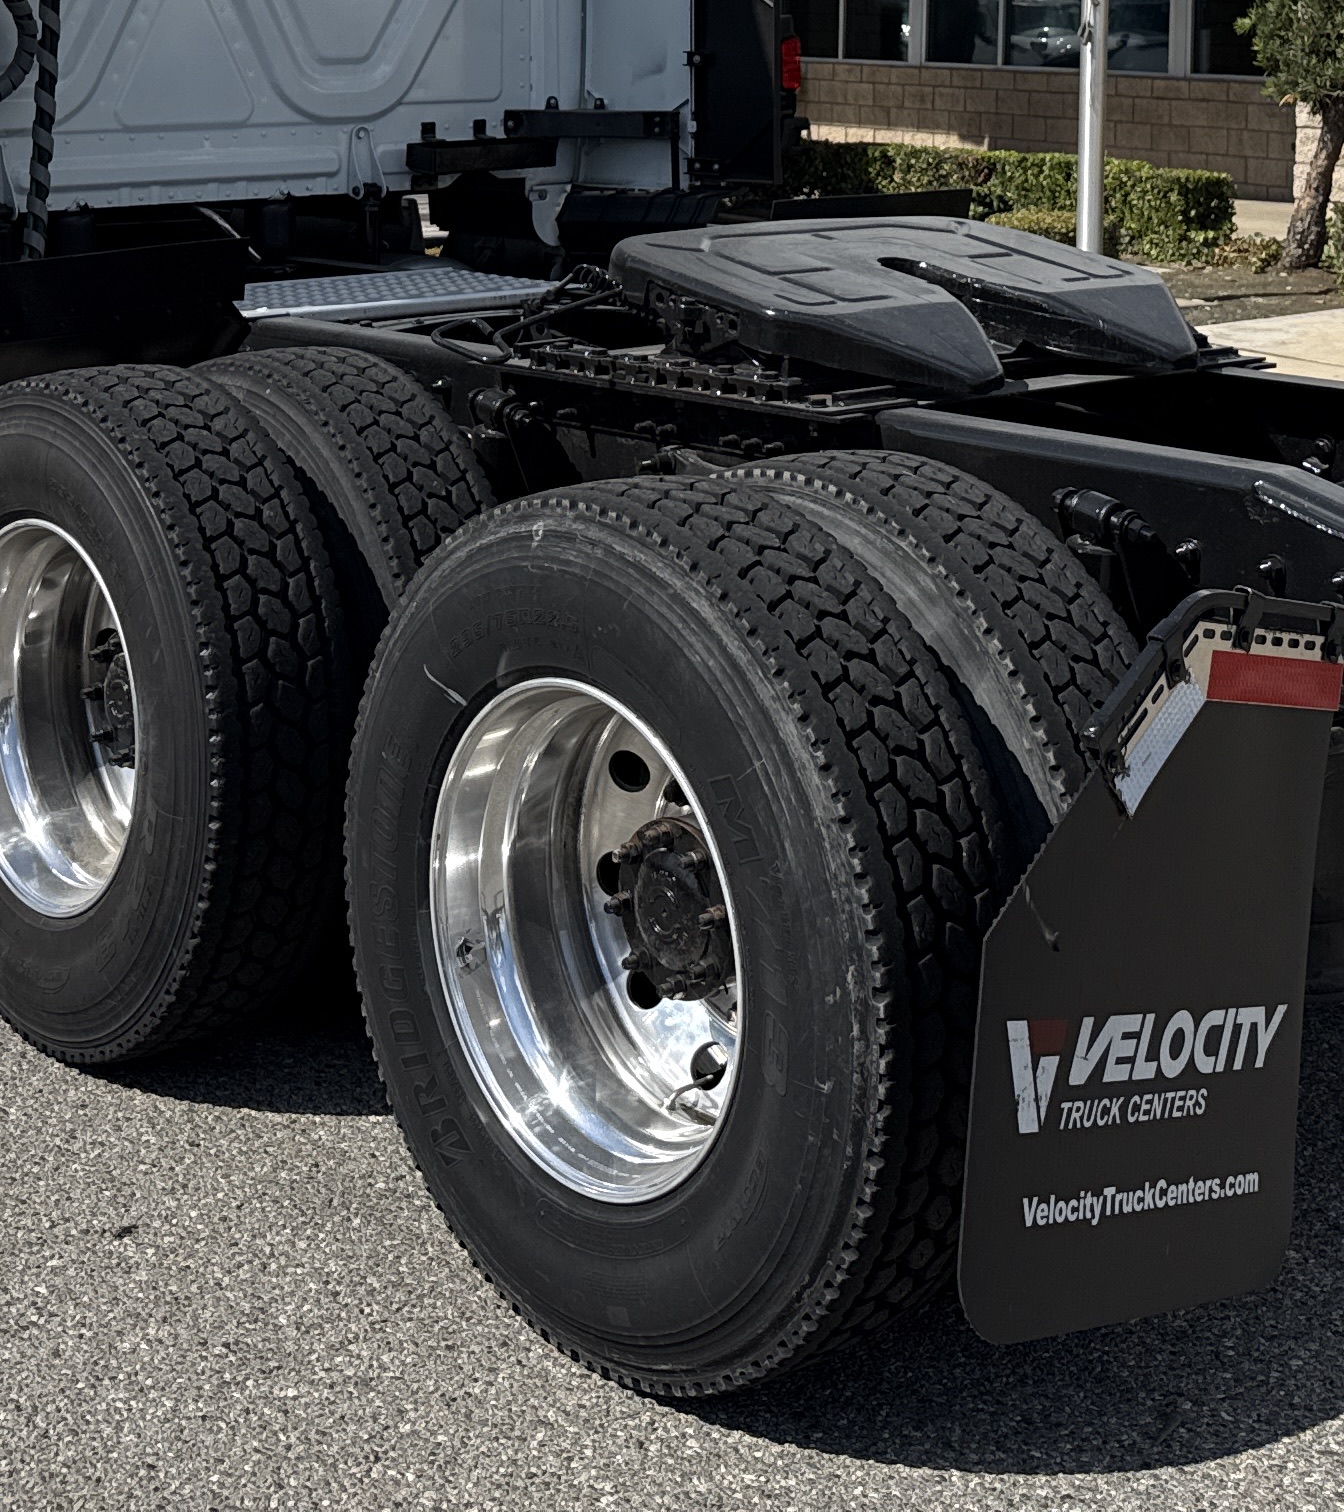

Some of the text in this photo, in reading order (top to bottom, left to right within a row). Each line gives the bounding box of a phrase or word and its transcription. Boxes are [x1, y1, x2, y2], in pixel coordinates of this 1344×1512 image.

[370, 730, 473, 1169] BRIDGESTONE
[1068, 1004, 1288, 1086] VELOCITY
[1059, 1088, 1208, 1130] TRUCK CENTERS
[1023, 1172, 1258, 1227] VelocityTruckCenters.com
